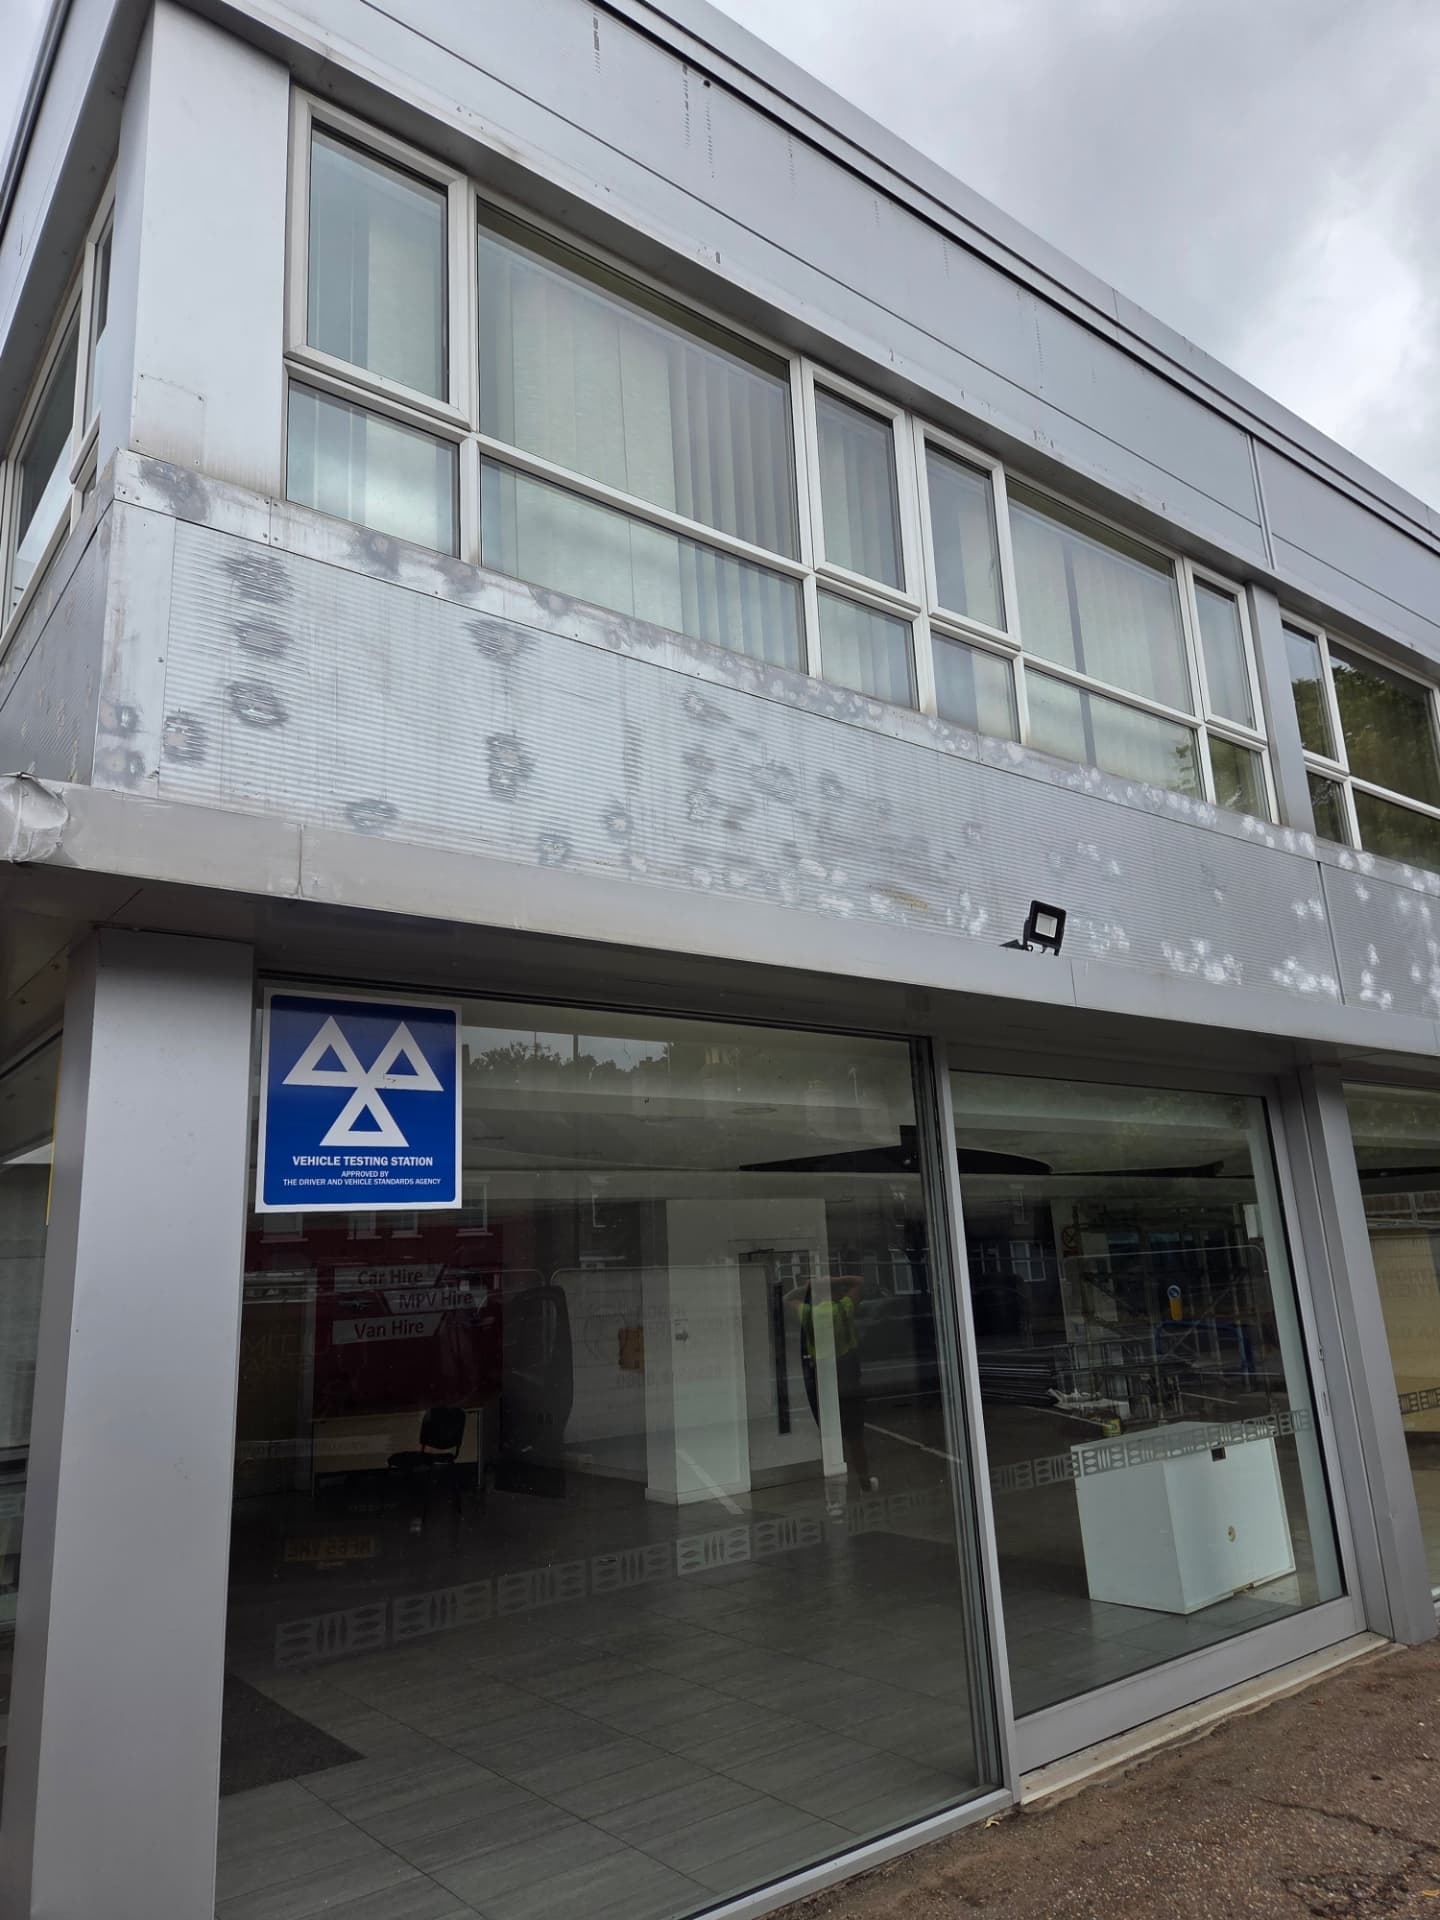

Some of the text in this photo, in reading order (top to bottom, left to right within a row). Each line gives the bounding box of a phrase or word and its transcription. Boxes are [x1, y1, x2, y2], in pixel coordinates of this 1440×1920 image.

[292, 1155, 433, 1167] VEHICLE TESTING STATION
[341, 1170, 389, 1178] APPROVED BY
[283, 1178, 297, 1187] THE
[298, 1178, 326, 1186] DRIVER
[327, 1178, 343, 1186] AND
[343, 1178, 373, 1186] VEHICLE
[373, 1178, 414, 1186] STANDARDS
[357, 1268, 423, 1285] Car Hire
[400, 1290, 474, 1309] MPV Hire
[354, 1319, 425, 1339] Van Hire
